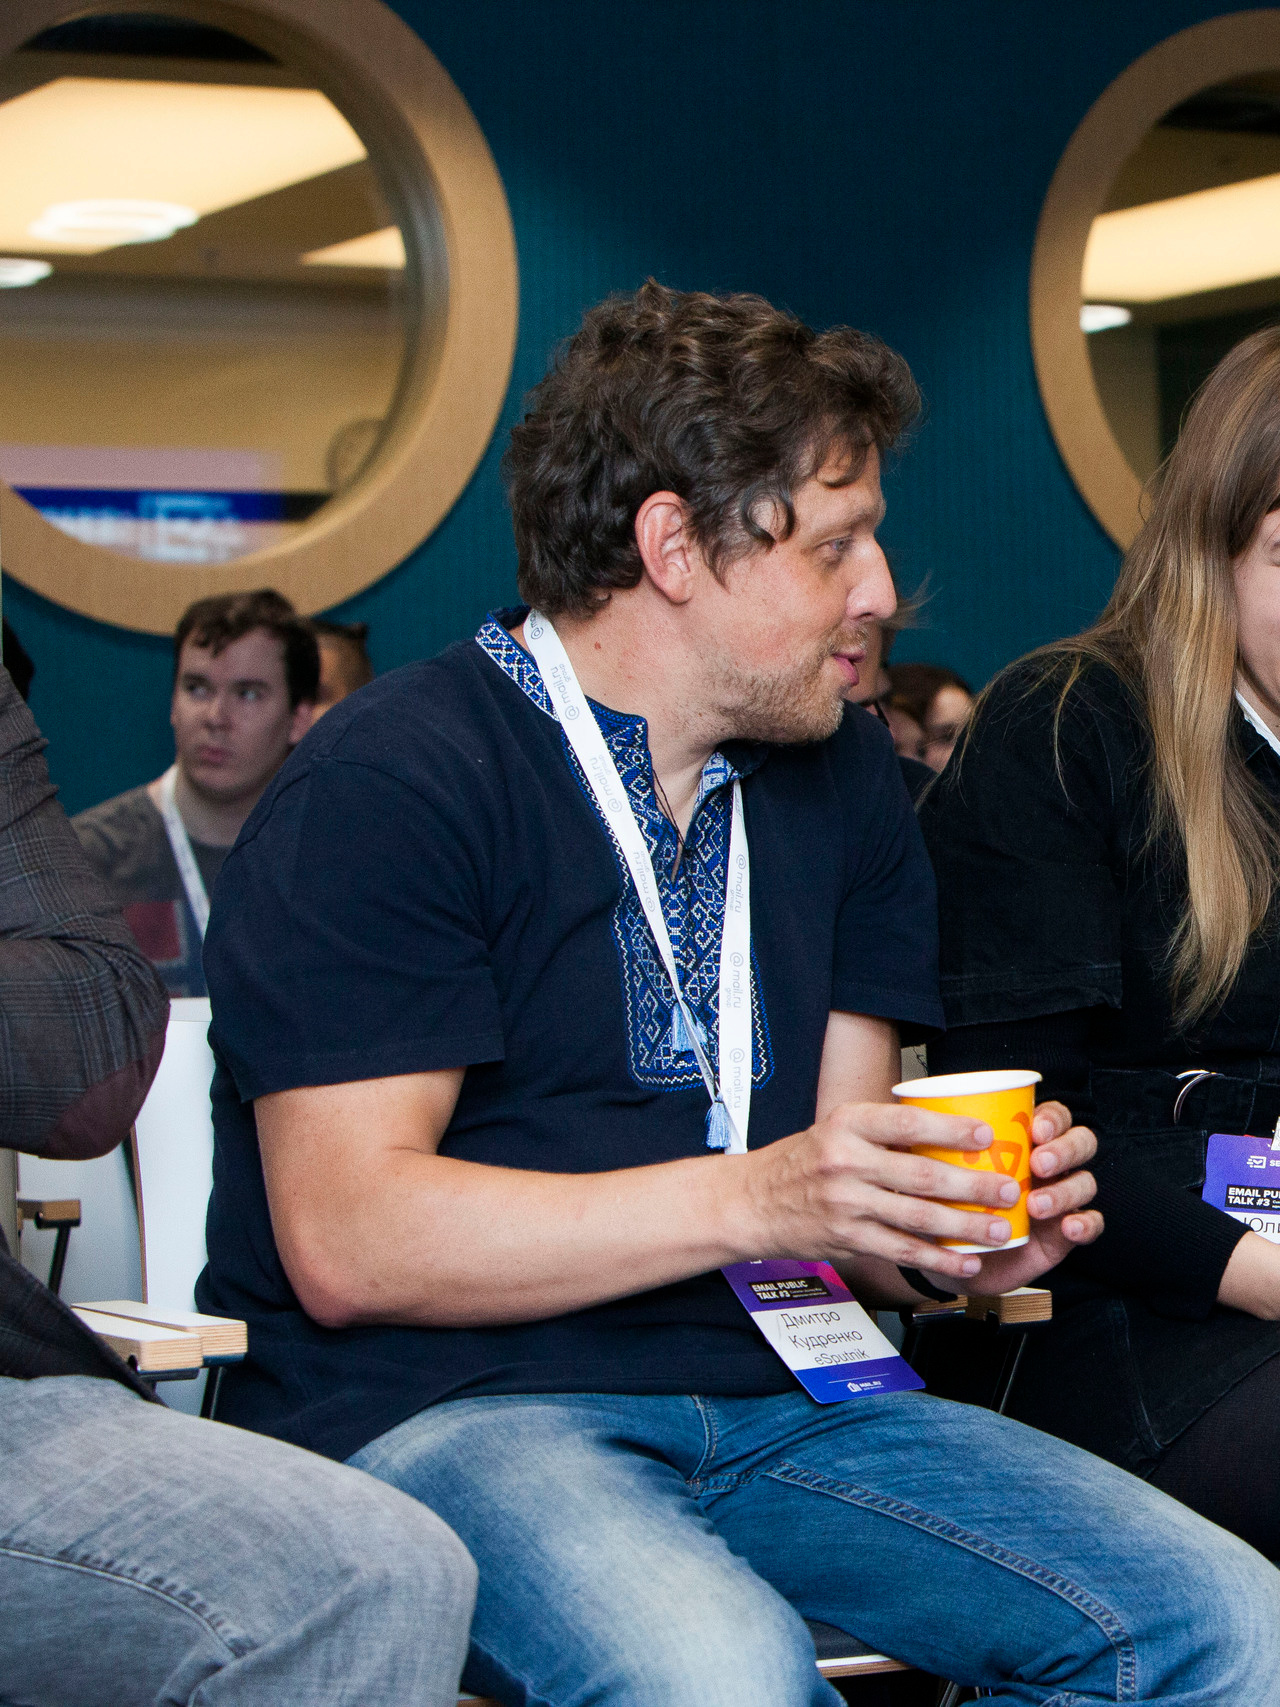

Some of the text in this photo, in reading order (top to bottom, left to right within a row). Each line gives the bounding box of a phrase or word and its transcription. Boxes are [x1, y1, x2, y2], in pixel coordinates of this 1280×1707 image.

[1228, 1187, 1261, 1198] EMAIL
[1228, 1195, 1271, 1207] TALK #3
[752, 1280, 808, 1293] EMAIL PUBLIC
[756, 1290, 780, 1300] TALK
[780, 1310, 841, 1329] Дмитро
[788, 1329, 863, 1351] Кудренко
[814, 1348, 870, 1366] eSputnik
